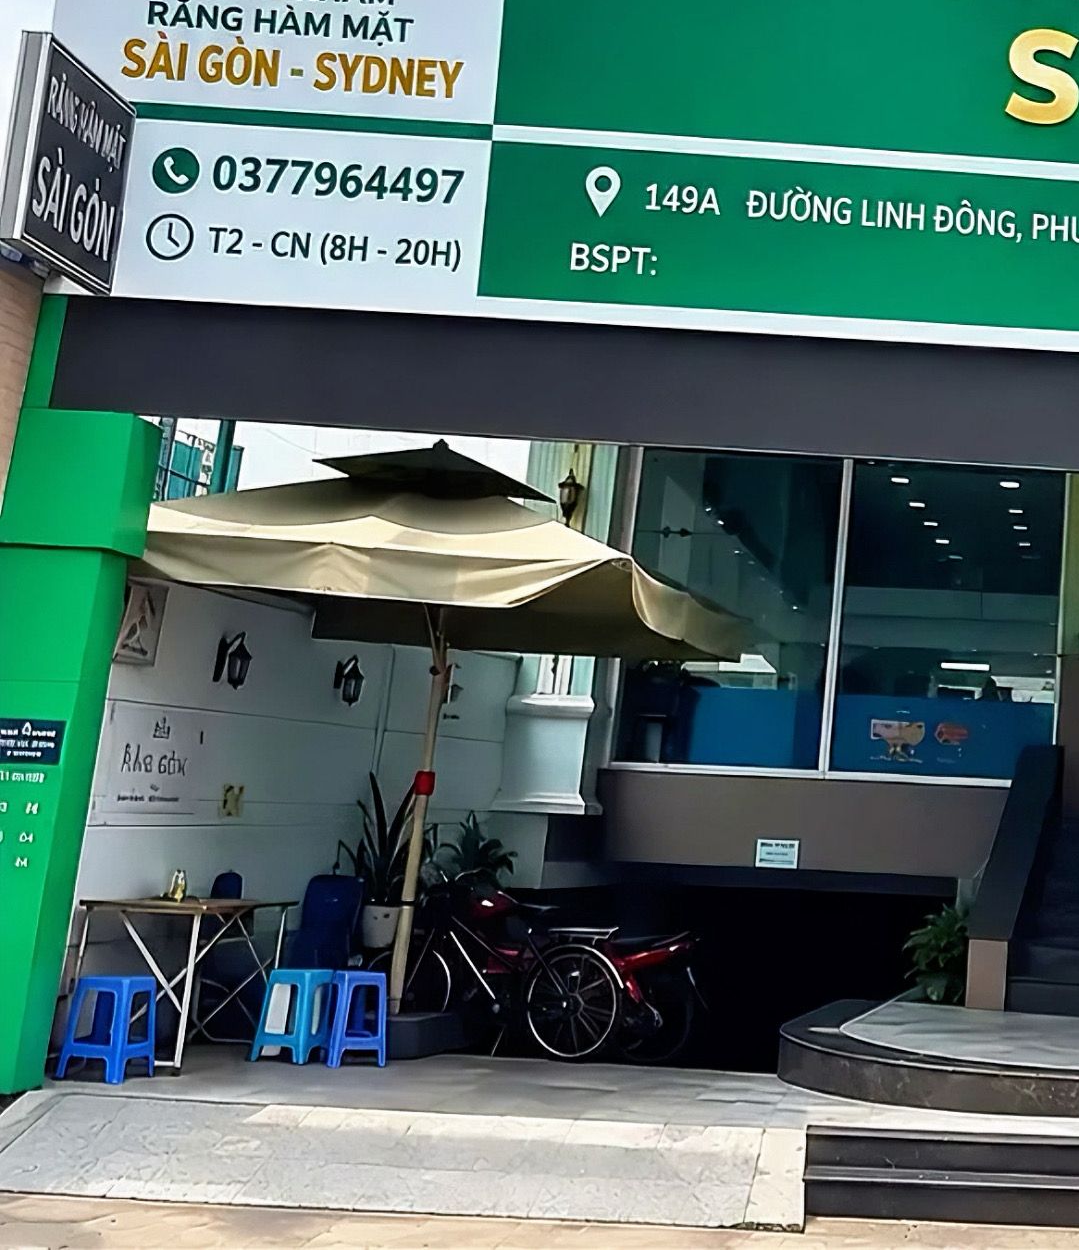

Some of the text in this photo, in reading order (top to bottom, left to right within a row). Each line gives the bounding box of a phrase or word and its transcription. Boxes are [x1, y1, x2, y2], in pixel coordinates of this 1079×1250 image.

[254, 4, 331, 38] HÀM
[342, 11, 414, 47] MẶT
[121, 30, 189, 81] SÀI
[199, 36, 281, 88] GÒN
[313, 52, 465, 99] SYDNEY
[212, 155, 465, 205] 0377964497
[644, 183, 721, 216] 149A
[746, 186, 852, 225] ĐƯỜNG
[861, 199, 926, 231] LINH
[933, 200, 1022, 243] ĐÔNG,
[208, 226, 243, 255] T2
[270, 231, 311, 259] CN
[320, 232, 369, 265] (8H
[395, 238, 462, 273] 20H)
[569, 242, 658, 276] BSPT:
